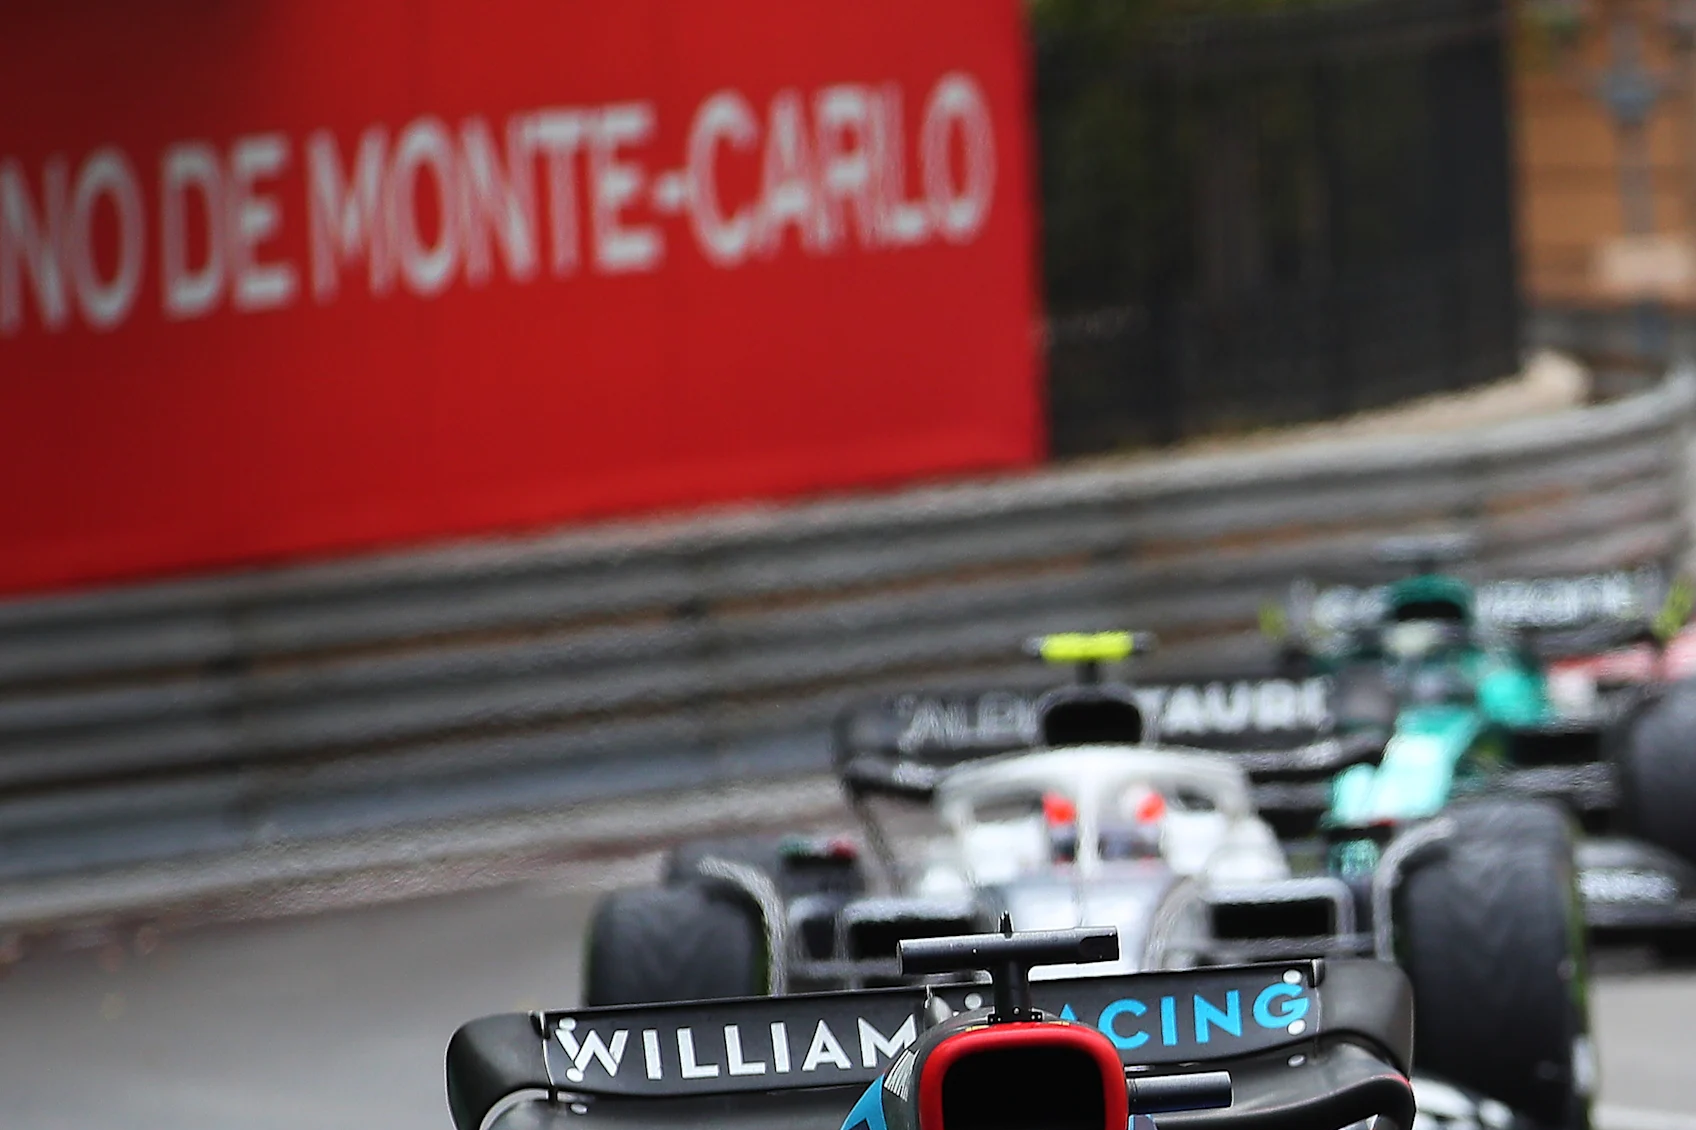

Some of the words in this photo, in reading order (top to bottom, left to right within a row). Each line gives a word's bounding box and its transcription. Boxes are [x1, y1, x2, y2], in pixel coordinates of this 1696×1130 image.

[160, 132, 296, 320] DE
[306, 72, 998, 304] MONTE-CARLO
[554, 1013, 918, 1079] WILLIAM
